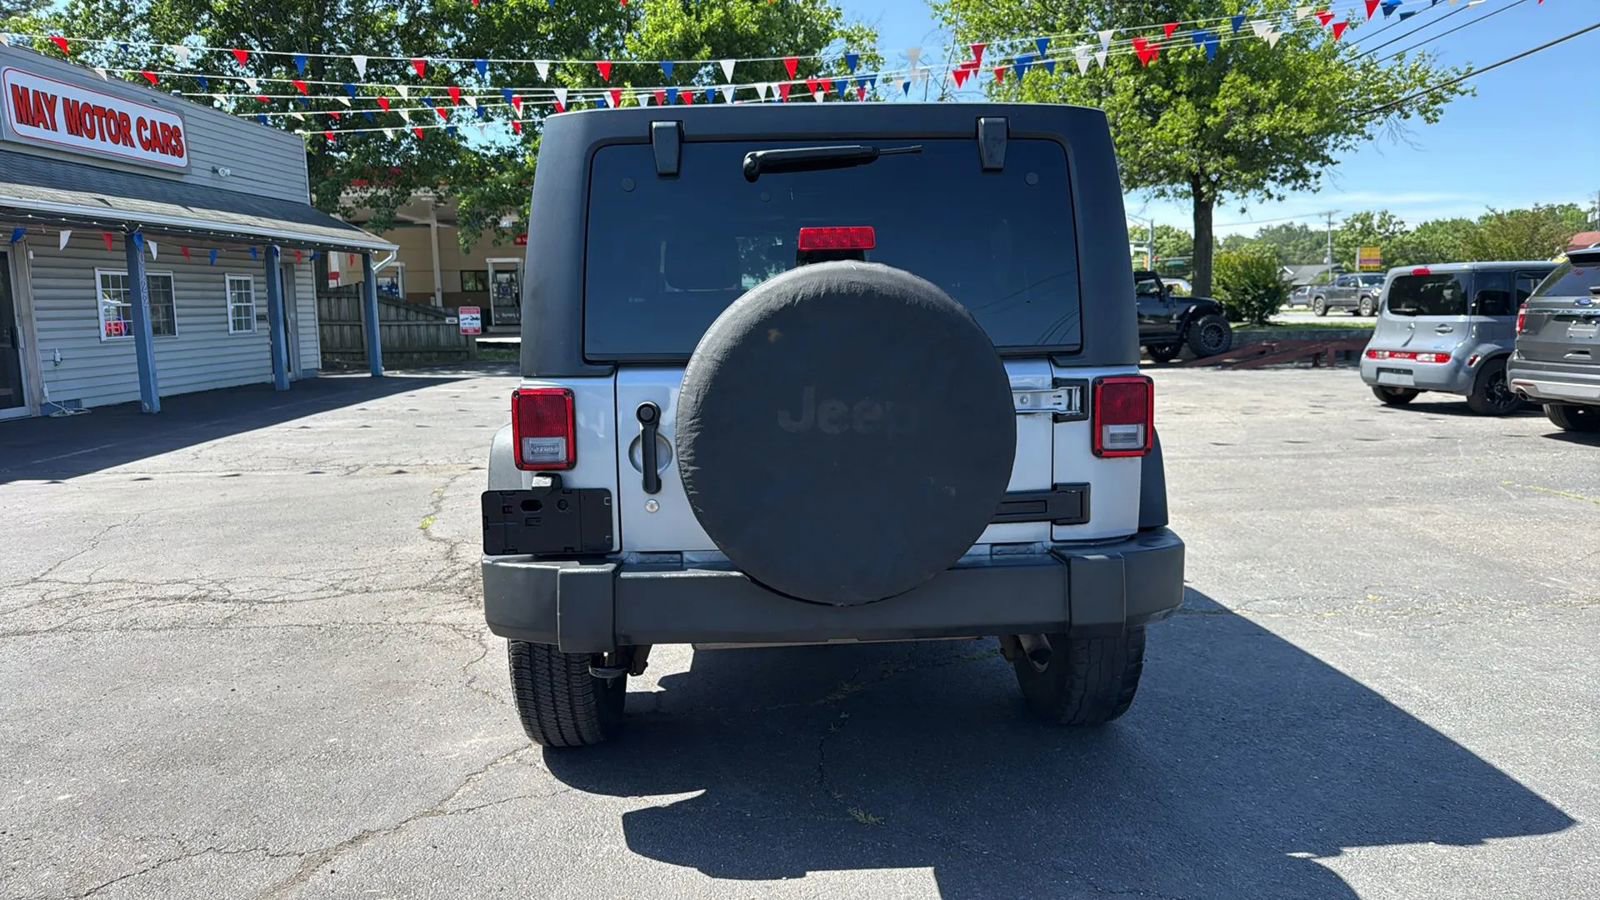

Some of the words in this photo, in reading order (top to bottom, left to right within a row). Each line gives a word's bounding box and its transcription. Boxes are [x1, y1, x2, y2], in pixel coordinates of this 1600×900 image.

[10, 83, 58, 132] MAY
[62, 97, 136, 149] MOTOR
[136, 116, 185, 159] CARS
